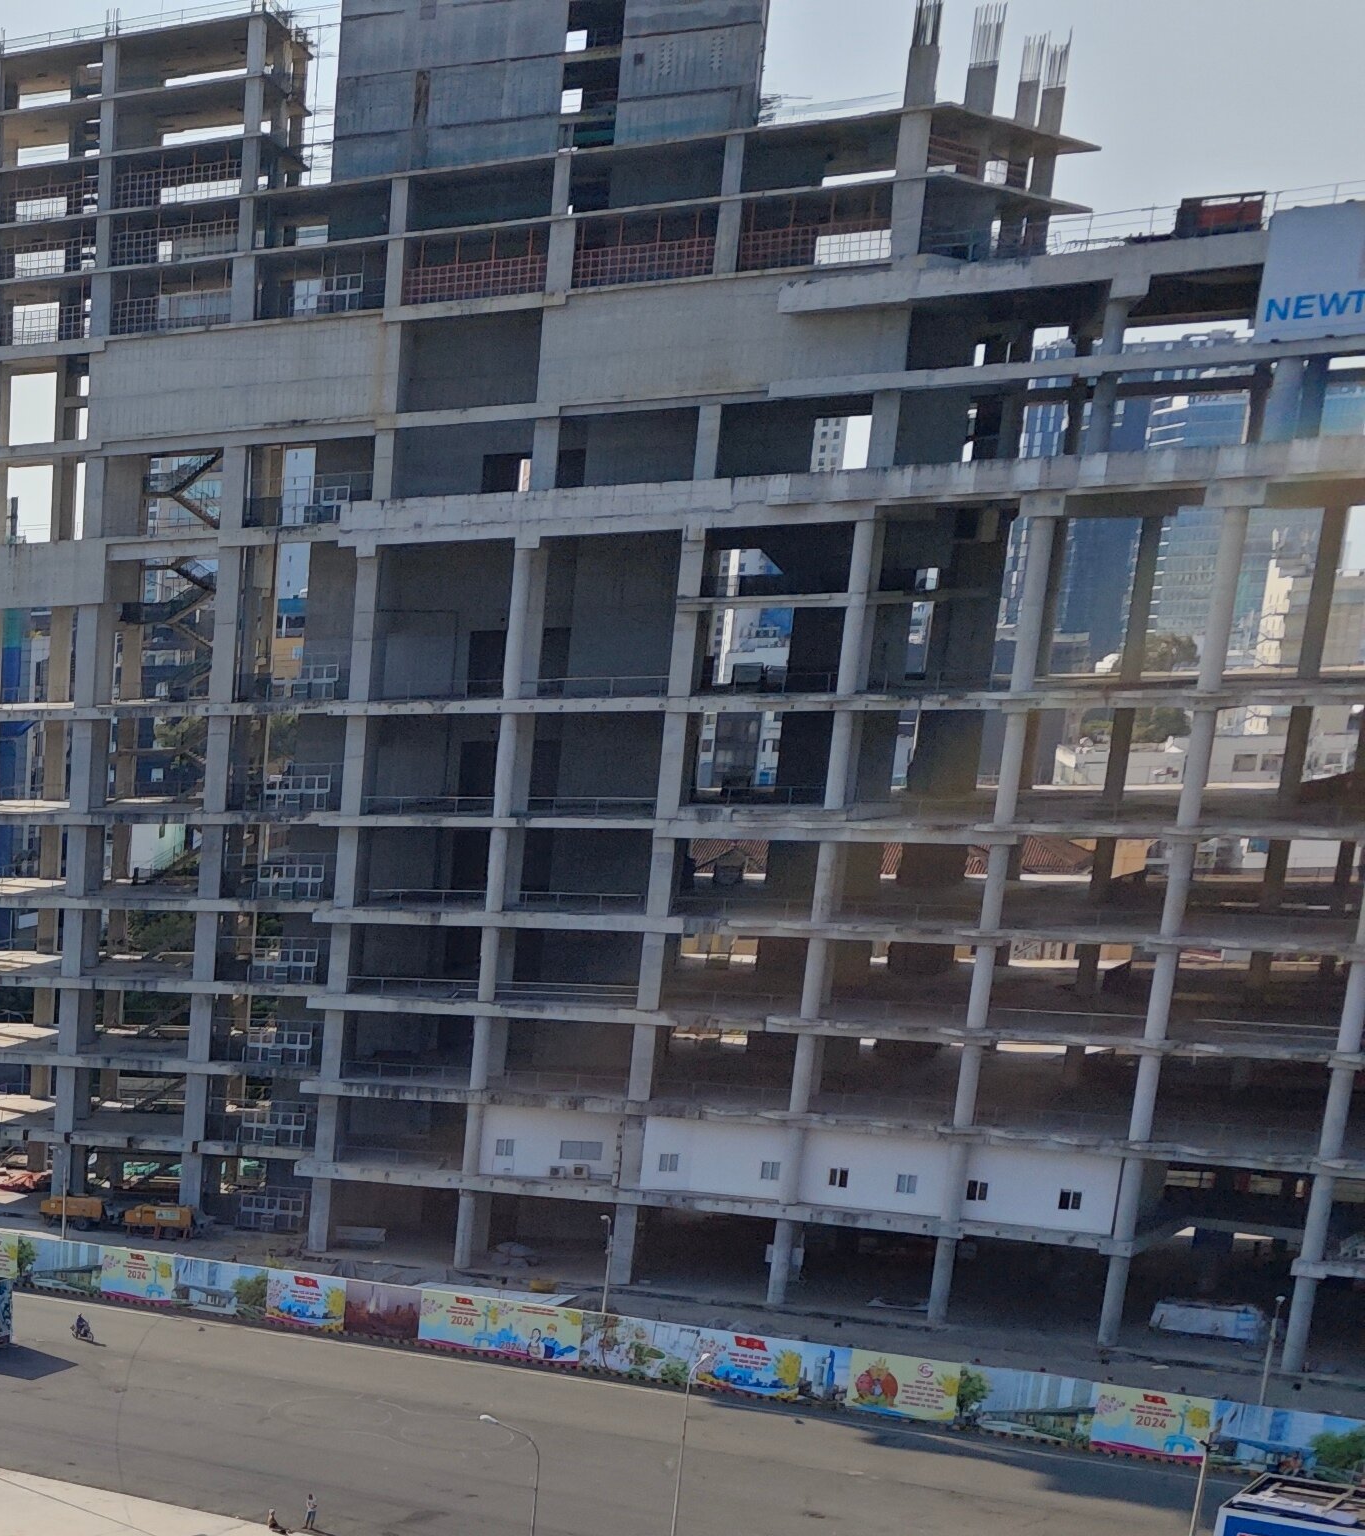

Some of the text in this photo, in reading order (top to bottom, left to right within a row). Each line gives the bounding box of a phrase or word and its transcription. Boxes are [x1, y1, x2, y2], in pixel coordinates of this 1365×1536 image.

[127, 1269, 147, 1280] 2024
[450, 1315, 475, 1327] 2024
[1135, 1415, 1167, 1429] 2024
